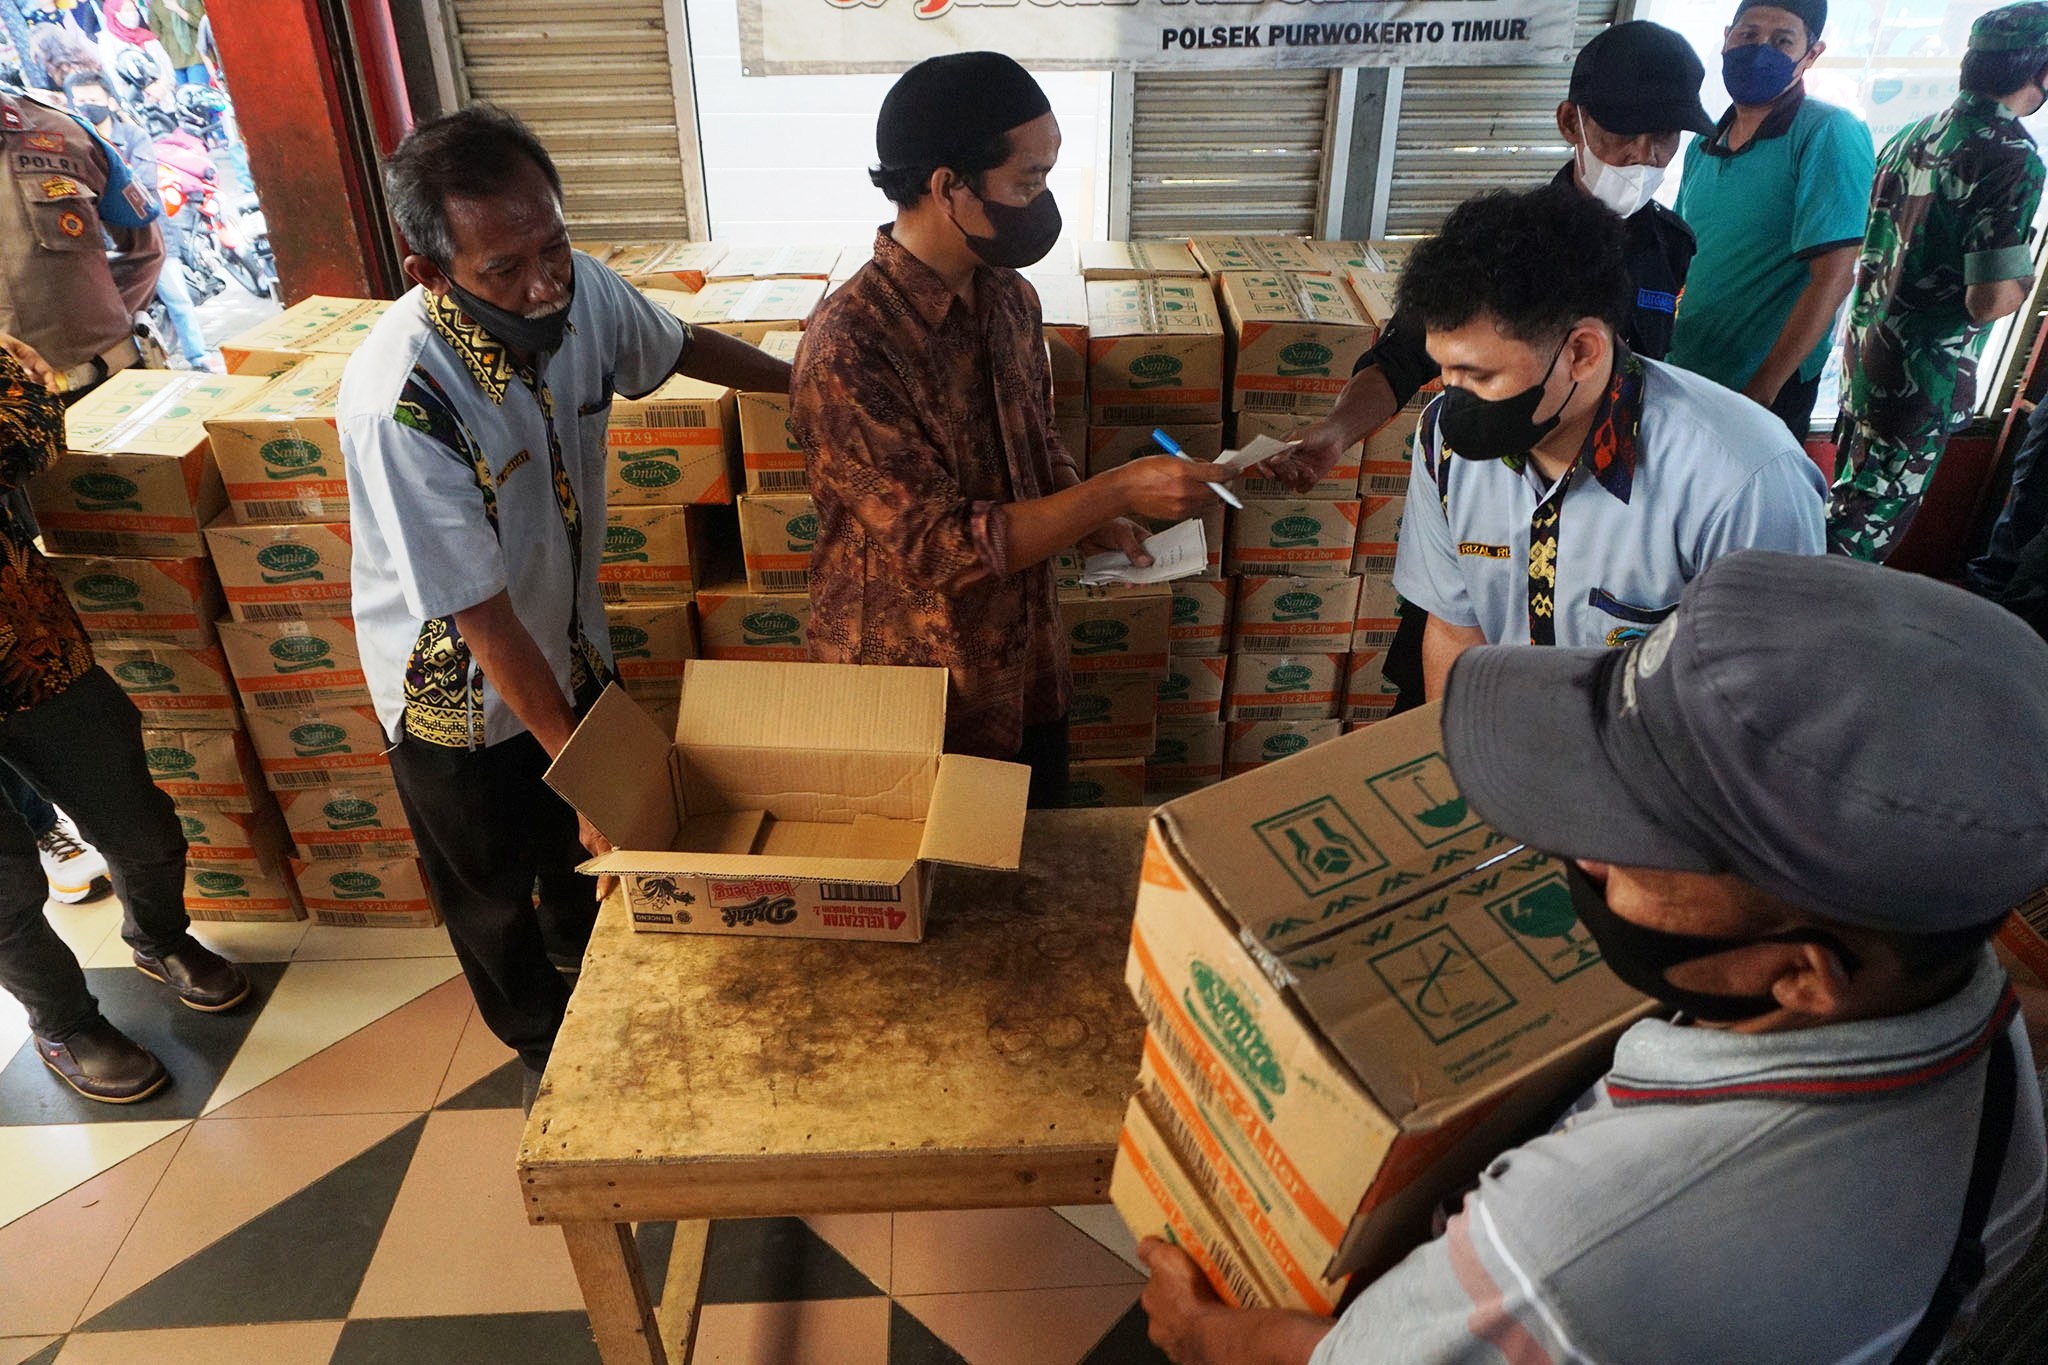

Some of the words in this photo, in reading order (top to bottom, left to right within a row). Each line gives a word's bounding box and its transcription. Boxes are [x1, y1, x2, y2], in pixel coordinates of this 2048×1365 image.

[1162, 26, 1260, 50] POLSEK
[1268, 22, 1444, 47] PURWOKERTO
[1451, 19, 1527, 42] TIMUR
[19, 155, 78, 173] POLRI
[1291, 348, 1323, 360] Sania
[632, 469, 669, 481] Sania
[1282, 521, 1311, 532] Sania
[606, 533, 636, 545] ania
[270, 549, 307, 563] Sania
[1461, 544, 1492, 556] RIZAL
[1282, 596, 1313, 607] Sania
[752, 617, 789, 629] Sania
[609, 632, 637, 643] ania
[281, 642, 318, 655] Sania
[1276, 669, 1304, 679] Sania
[301, 728, 335, 741] Sania
[148, 752, 185, 764] Sania
[713, 881, 796, 901] beng-beng
[634, 913, 672, 923] RENCENG
[720, 896, 799, 928] Drink
[884, 904, 907, 930] 4
[822, 914, 884, 929] KELEZATAN
[1206, 982, 1266, 1067] Sania
